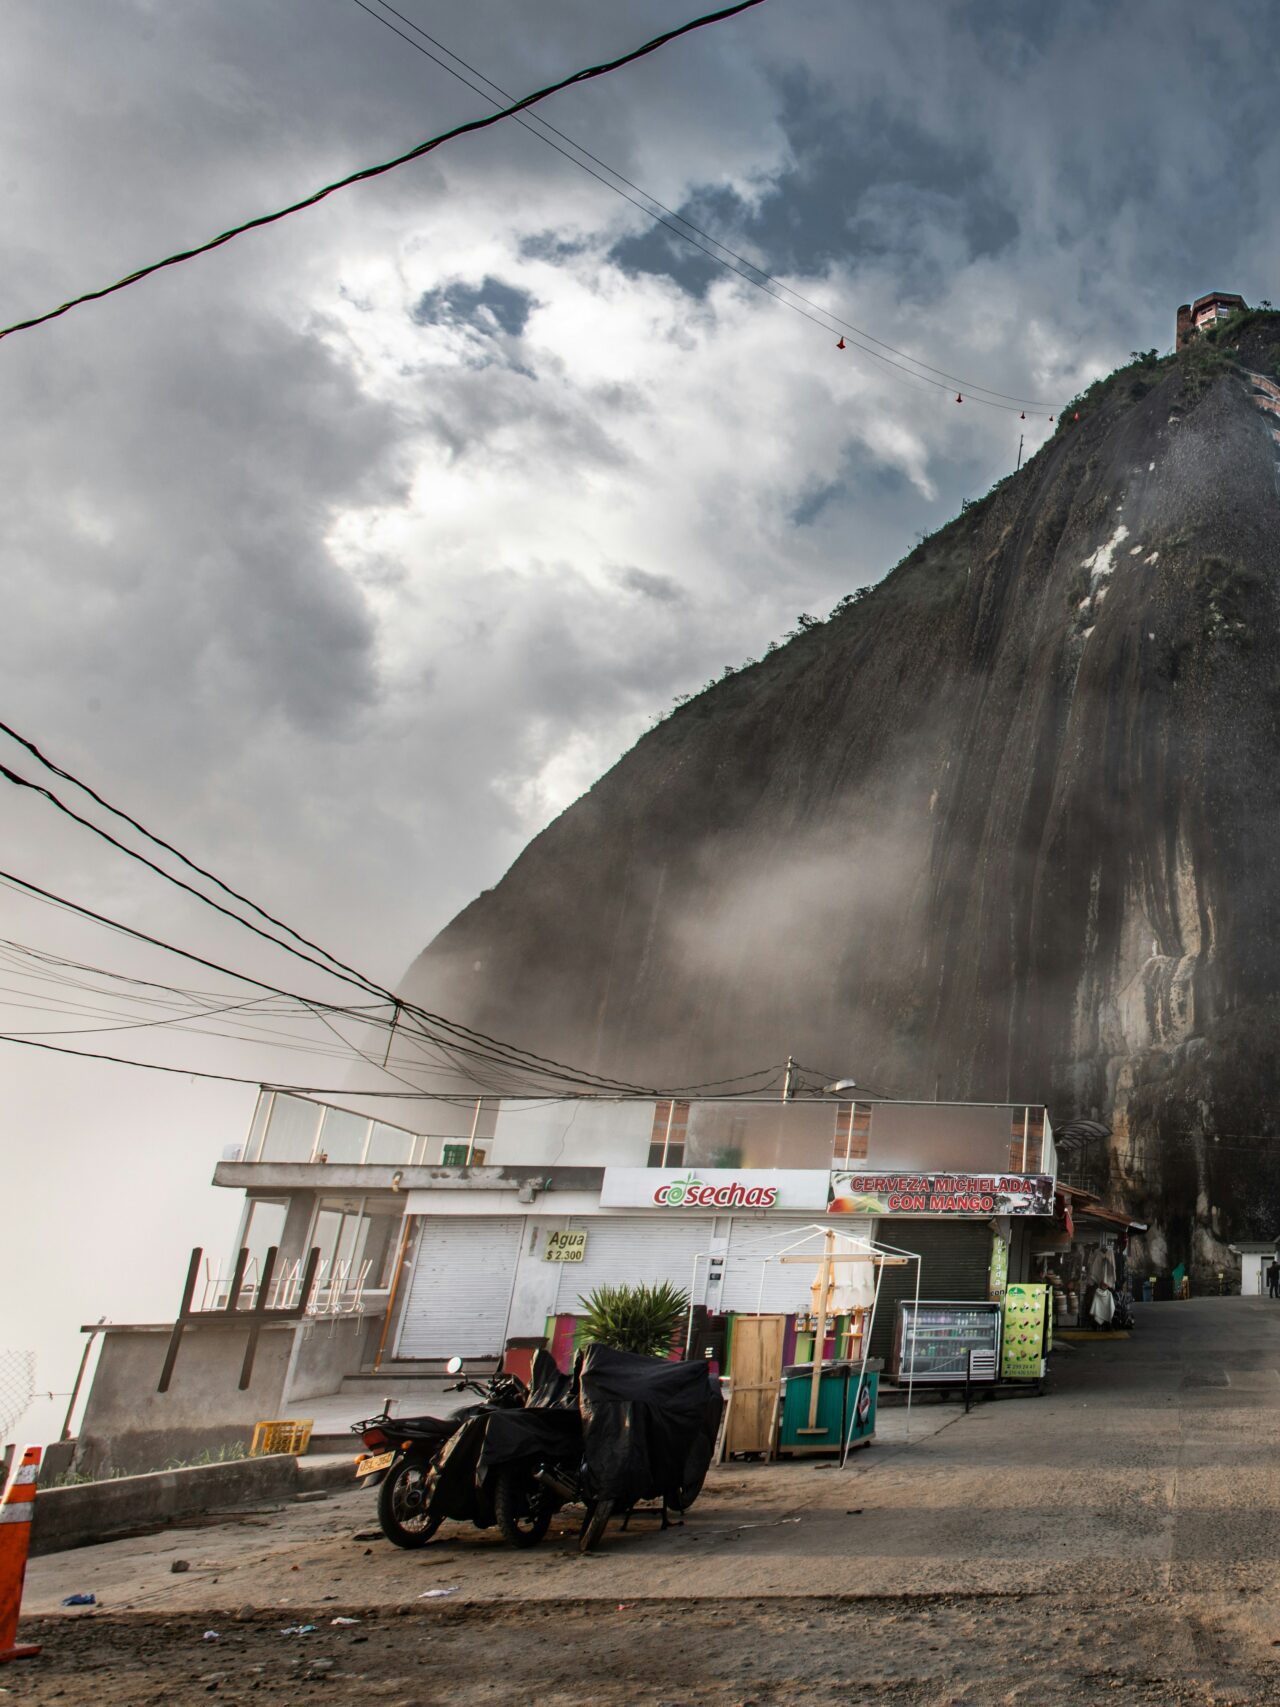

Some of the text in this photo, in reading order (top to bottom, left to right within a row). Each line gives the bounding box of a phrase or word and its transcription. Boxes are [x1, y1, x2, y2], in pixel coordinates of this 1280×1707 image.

[850, 1176, 1032, 1194] CERVEZA MICHELADA
[888, 1194, 993, 1211] CON MANGO
[549, 1231, 585, 1249] Agua
[547, 1250, 582, 1260] $ 2.300
